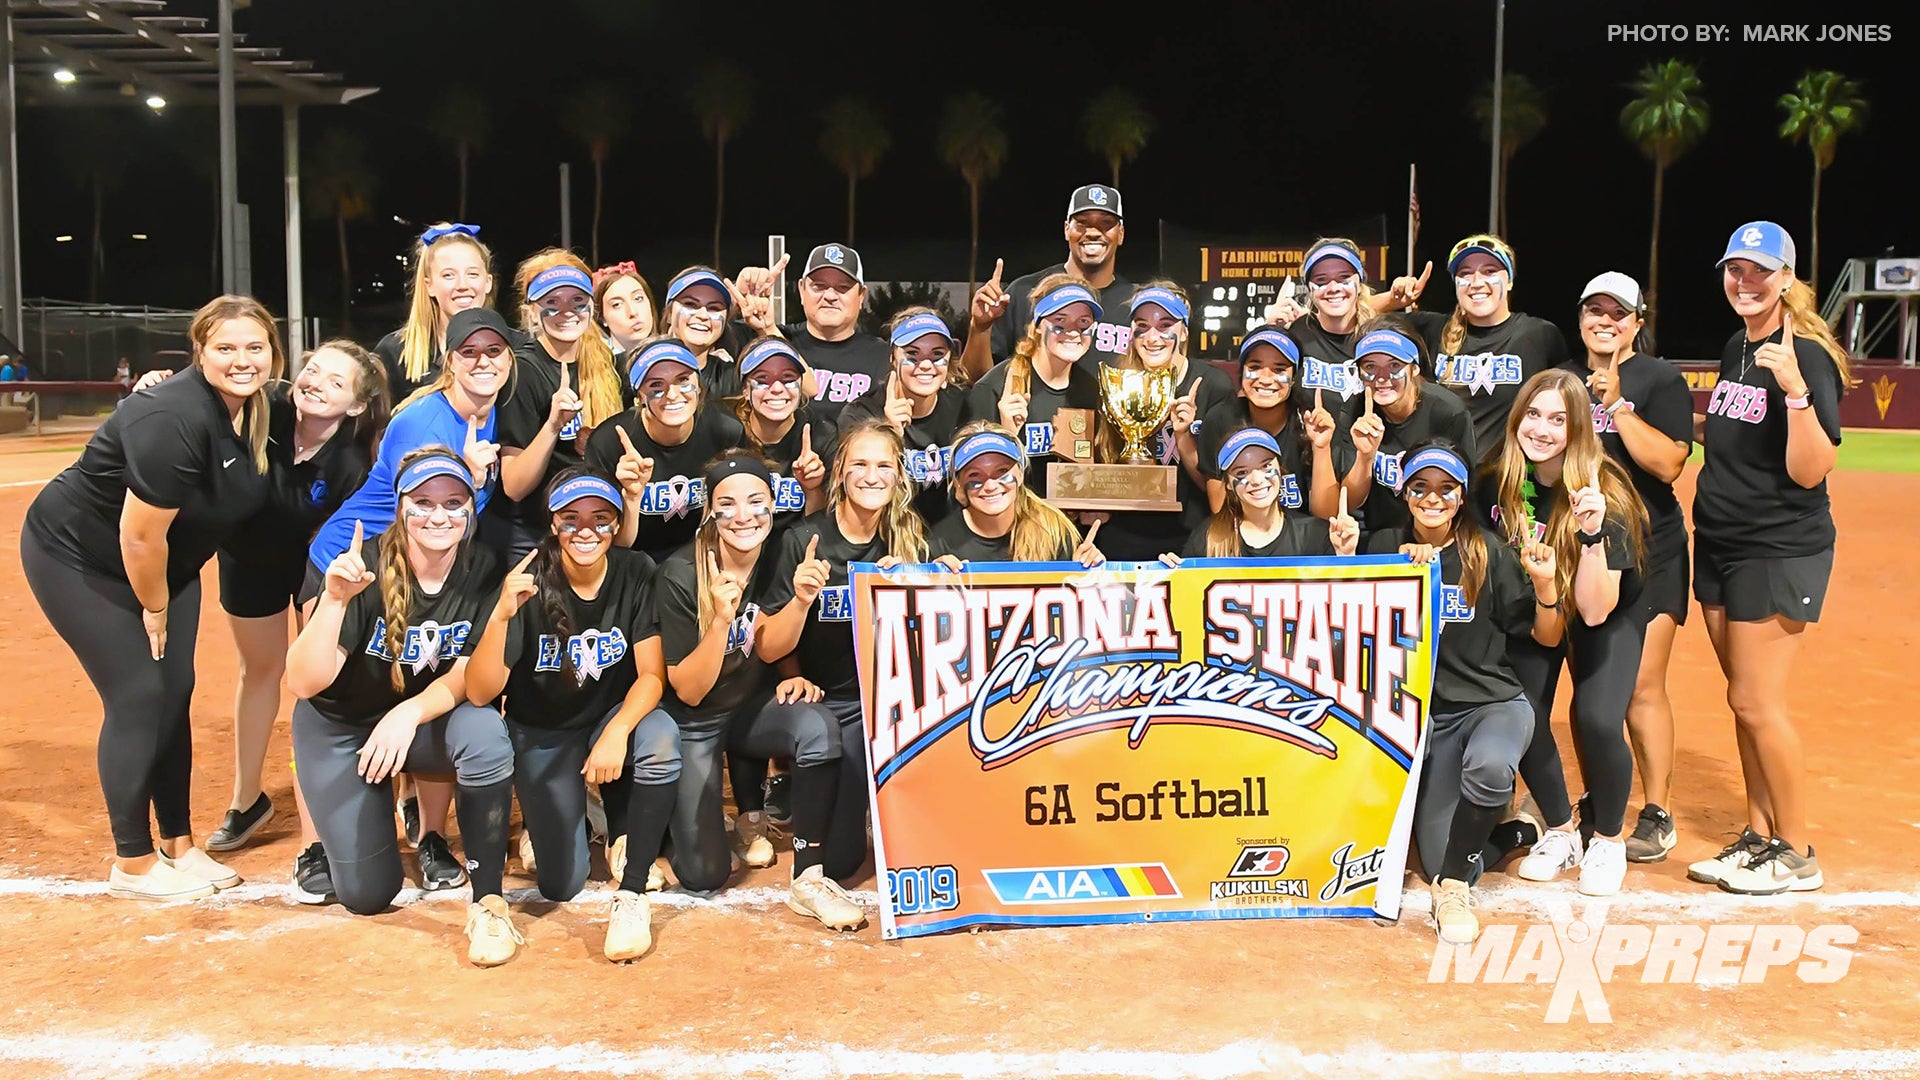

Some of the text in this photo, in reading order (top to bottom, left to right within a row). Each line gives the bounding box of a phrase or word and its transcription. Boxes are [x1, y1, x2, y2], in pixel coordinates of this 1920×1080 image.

[1221, 251, 1302, 263] FARRINGTON
[1221, 267, 1250, 277] HOME
[1252, 267, 1264, 277] OF
[1265, 267, 1286, 277] SUN
[810, 368, 871, 402] VSB
[1707, 379, 1769, 425] CVSB
[871, 577, 1421, 765] ARIZONA STATE
[968, 636, 1337, 762] Champions
[1024, 777, 1269, 826] 6A Softball
[1236, 837, 1290, 846] Sponsored by
[886, 863, 960, 917] 2019
[1024, 870, 1101, 900] AIA
[1210, 879, 1309, 901] KUKULSKI
[1236, 896, 1284, 905] BROTHERS
